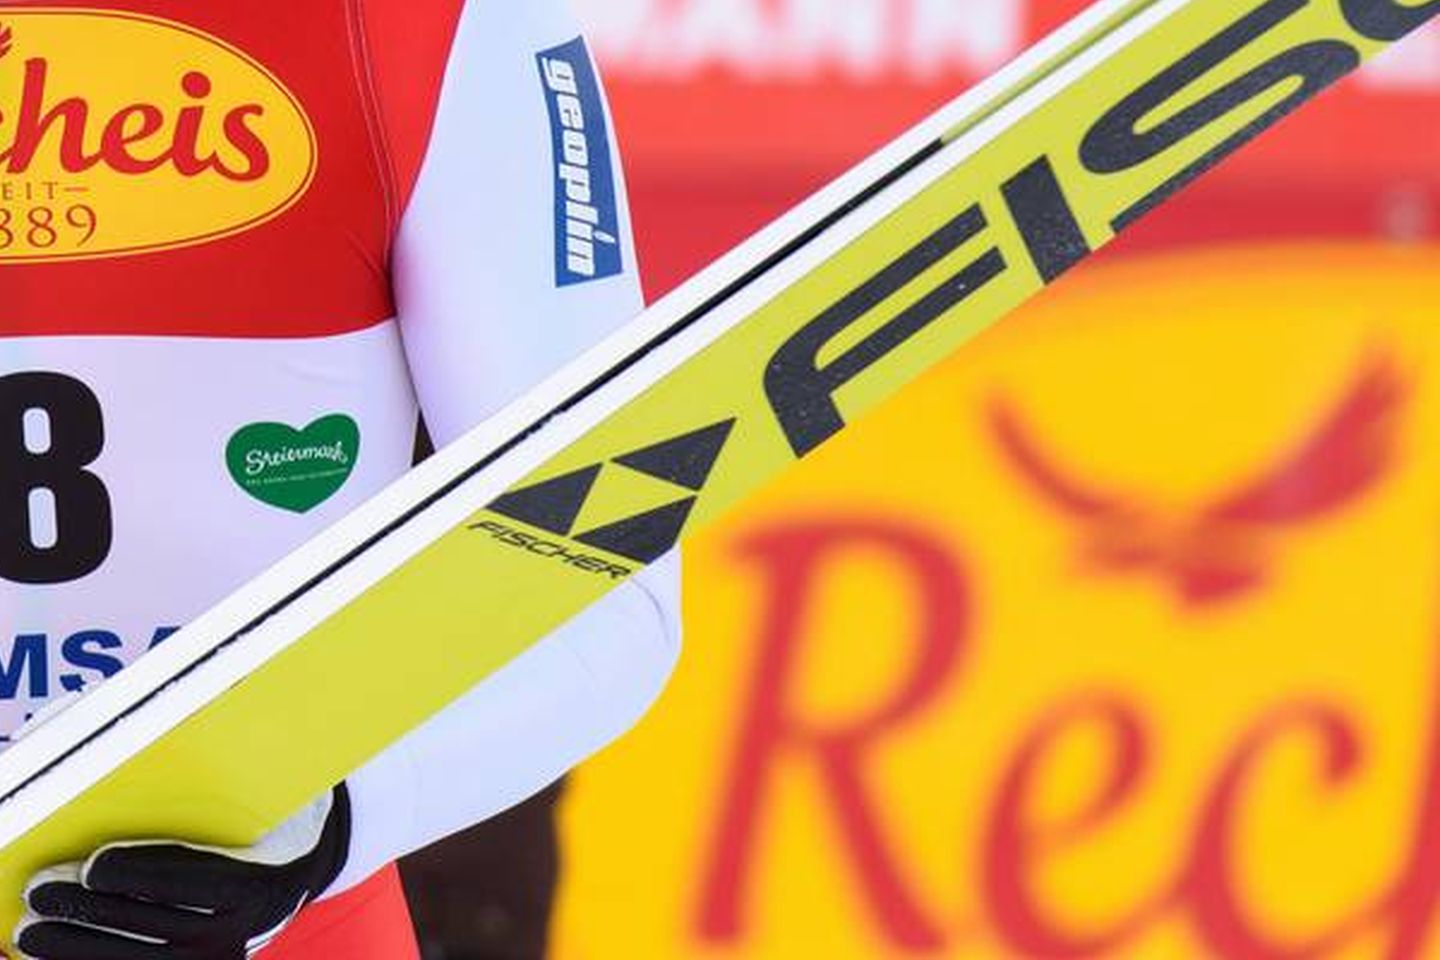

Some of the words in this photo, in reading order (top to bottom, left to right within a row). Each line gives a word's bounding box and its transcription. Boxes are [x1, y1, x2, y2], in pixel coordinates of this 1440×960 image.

[542, 57, 616, 277] geoplin
[245, 440, 348, 476] Steiermark
[467, 520, 633, 580] FISCHER
